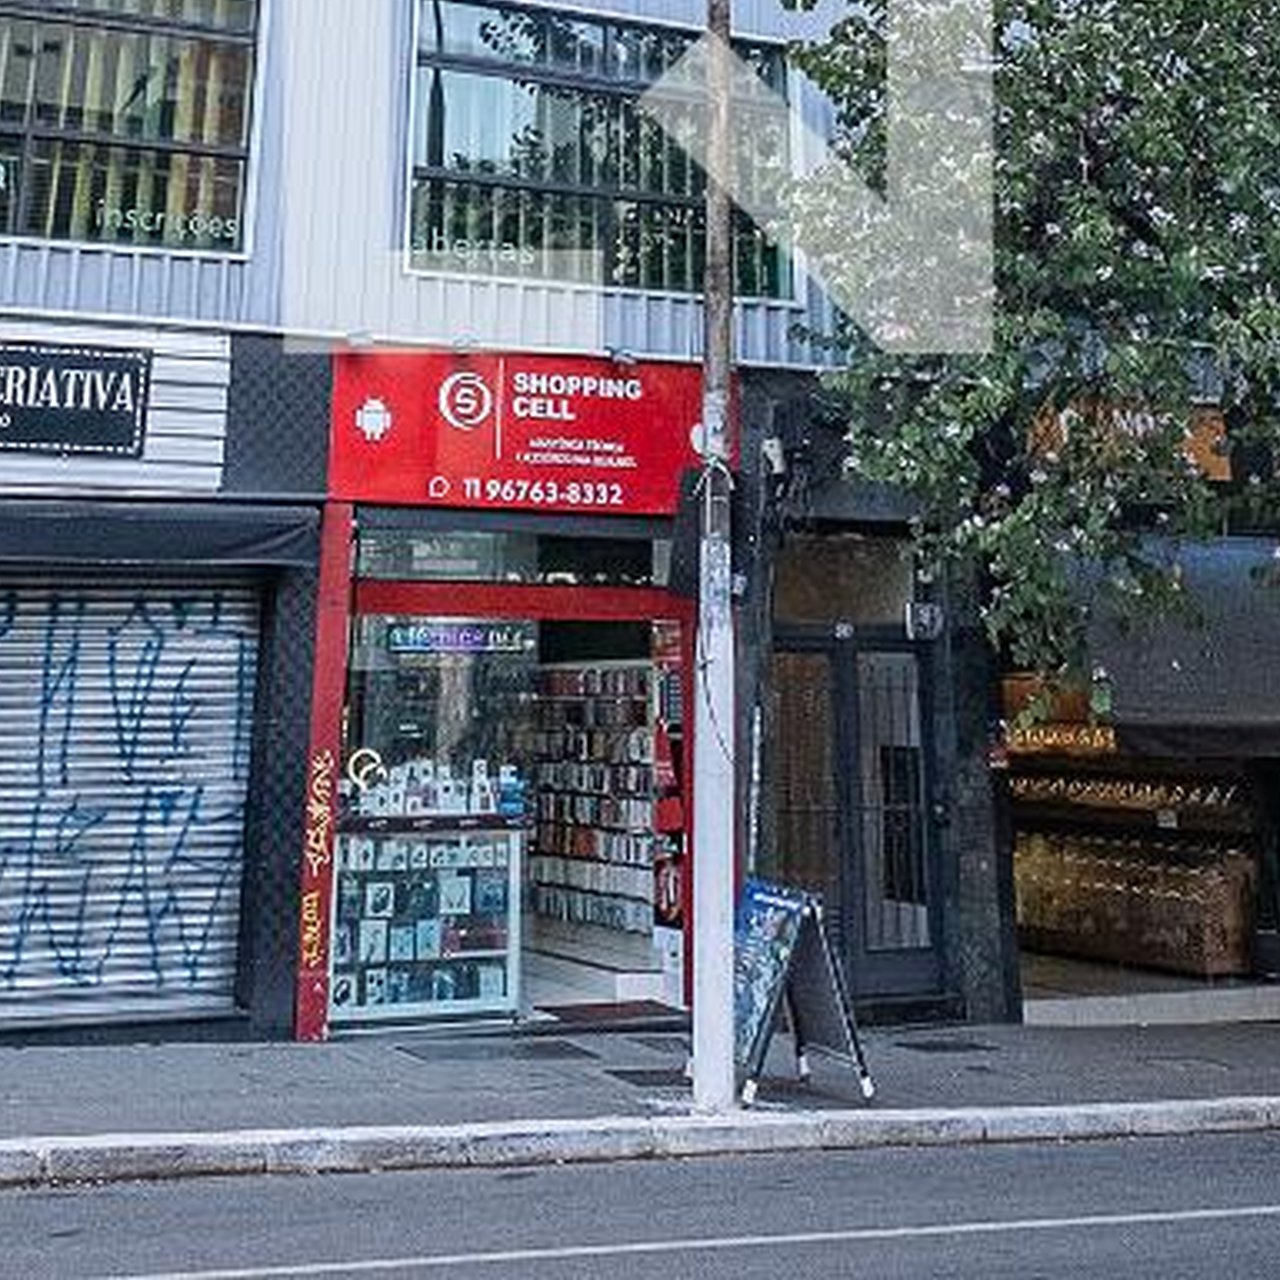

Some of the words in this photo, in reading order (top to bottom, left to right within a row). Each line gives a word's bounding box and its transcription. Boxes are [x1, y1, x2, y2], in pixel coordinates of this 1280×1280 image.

[512, 372, 642, 400] SHOPPING
[512, 396, 576, 420] CELL
[485, 478, 623, 505] 96763-8332
